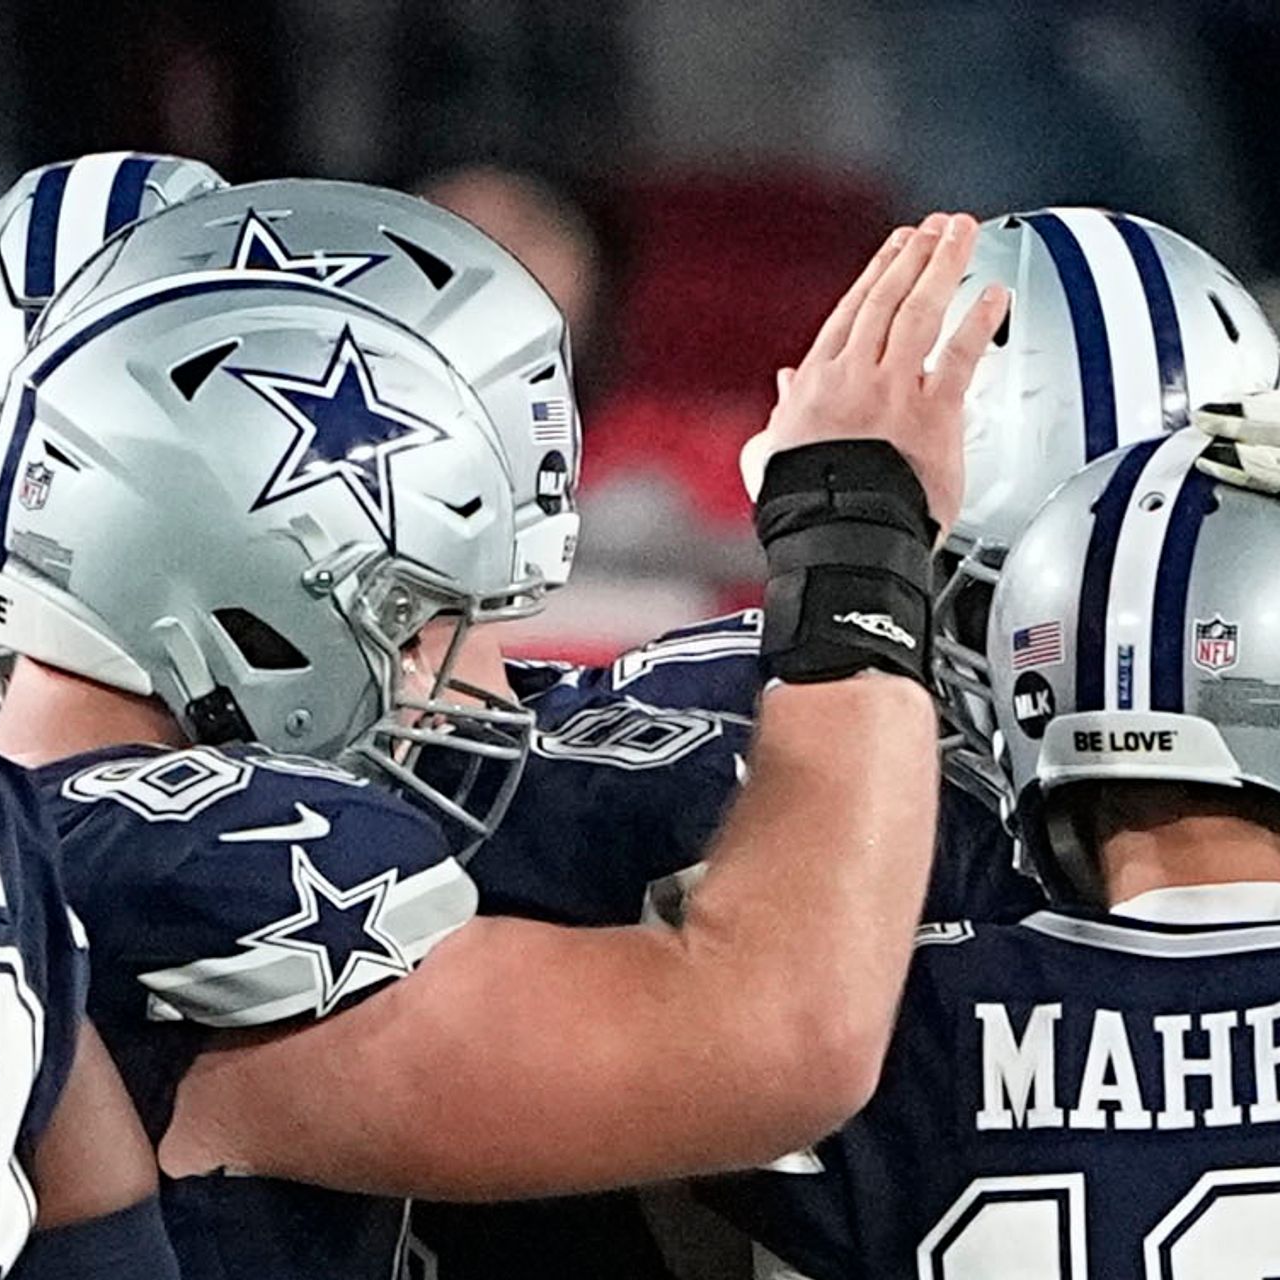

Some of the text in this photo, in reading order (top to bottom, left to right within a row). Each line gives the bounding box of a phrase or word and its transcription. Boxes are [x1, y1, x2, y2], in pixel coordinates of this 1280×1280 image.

[1197, 640, 1234, 665] NFL
[1015, 690, 1052, 720] MLK
[1073, 730, 1174, 753] BE LOVE
